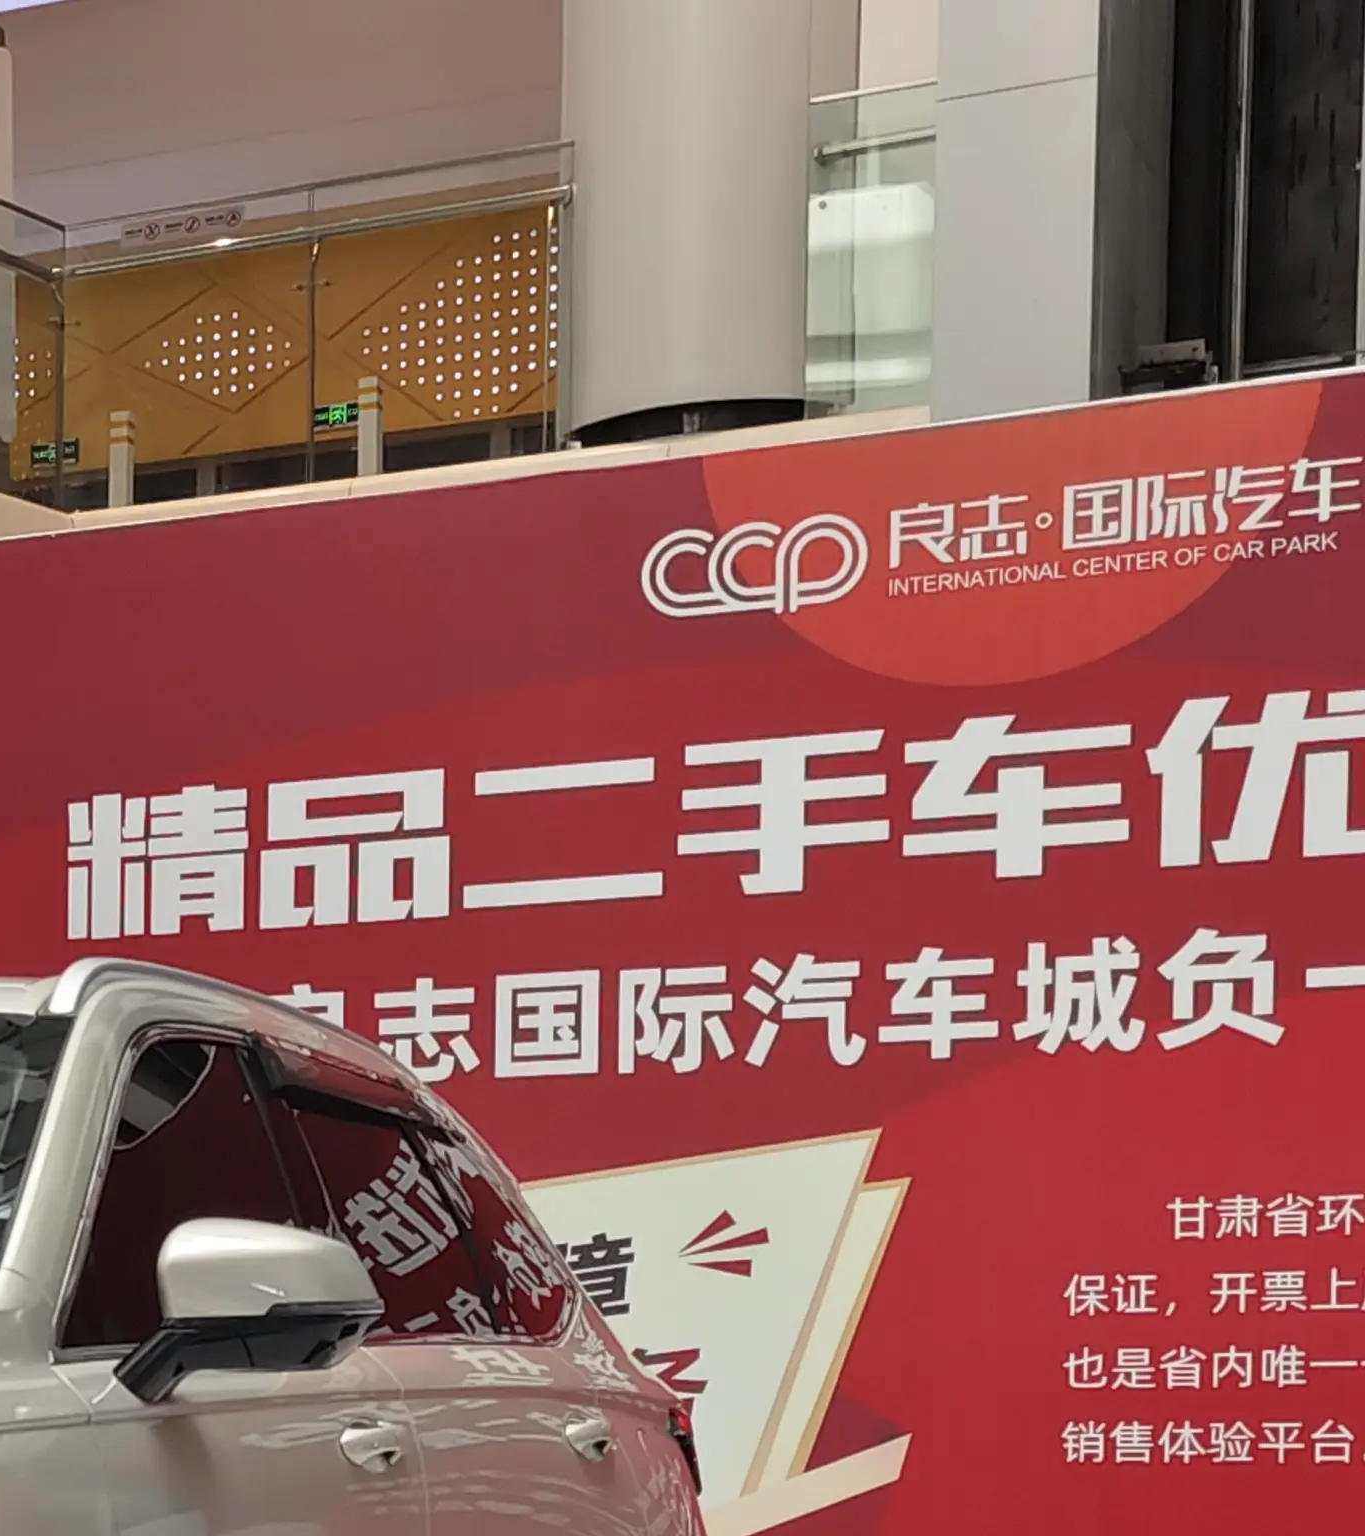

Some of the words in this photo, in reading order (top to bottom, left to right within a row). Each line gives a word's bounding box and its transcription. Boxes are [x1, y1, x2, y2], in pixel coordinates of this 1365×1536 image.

[888, 562, 1066, 597] INTERNATIONAL
[1072, 550, 1167, 578] CENTER
[1174, 546, 1206, 566] OF
[1213, 540, 1264, 563] CAR
[1271, 532, 1338, 557] PARK
[68, 689, 1365, 940] 精品二手车优
[1166, 1192, 1365, 1240] 甘肃省环
[1063, 1267, 1365, 1316] 保证，开票上
[1062, 1344, 1365, 1390] 也是省内唯一
[1061, 1418, 1365, 1464] 销售体验平台
